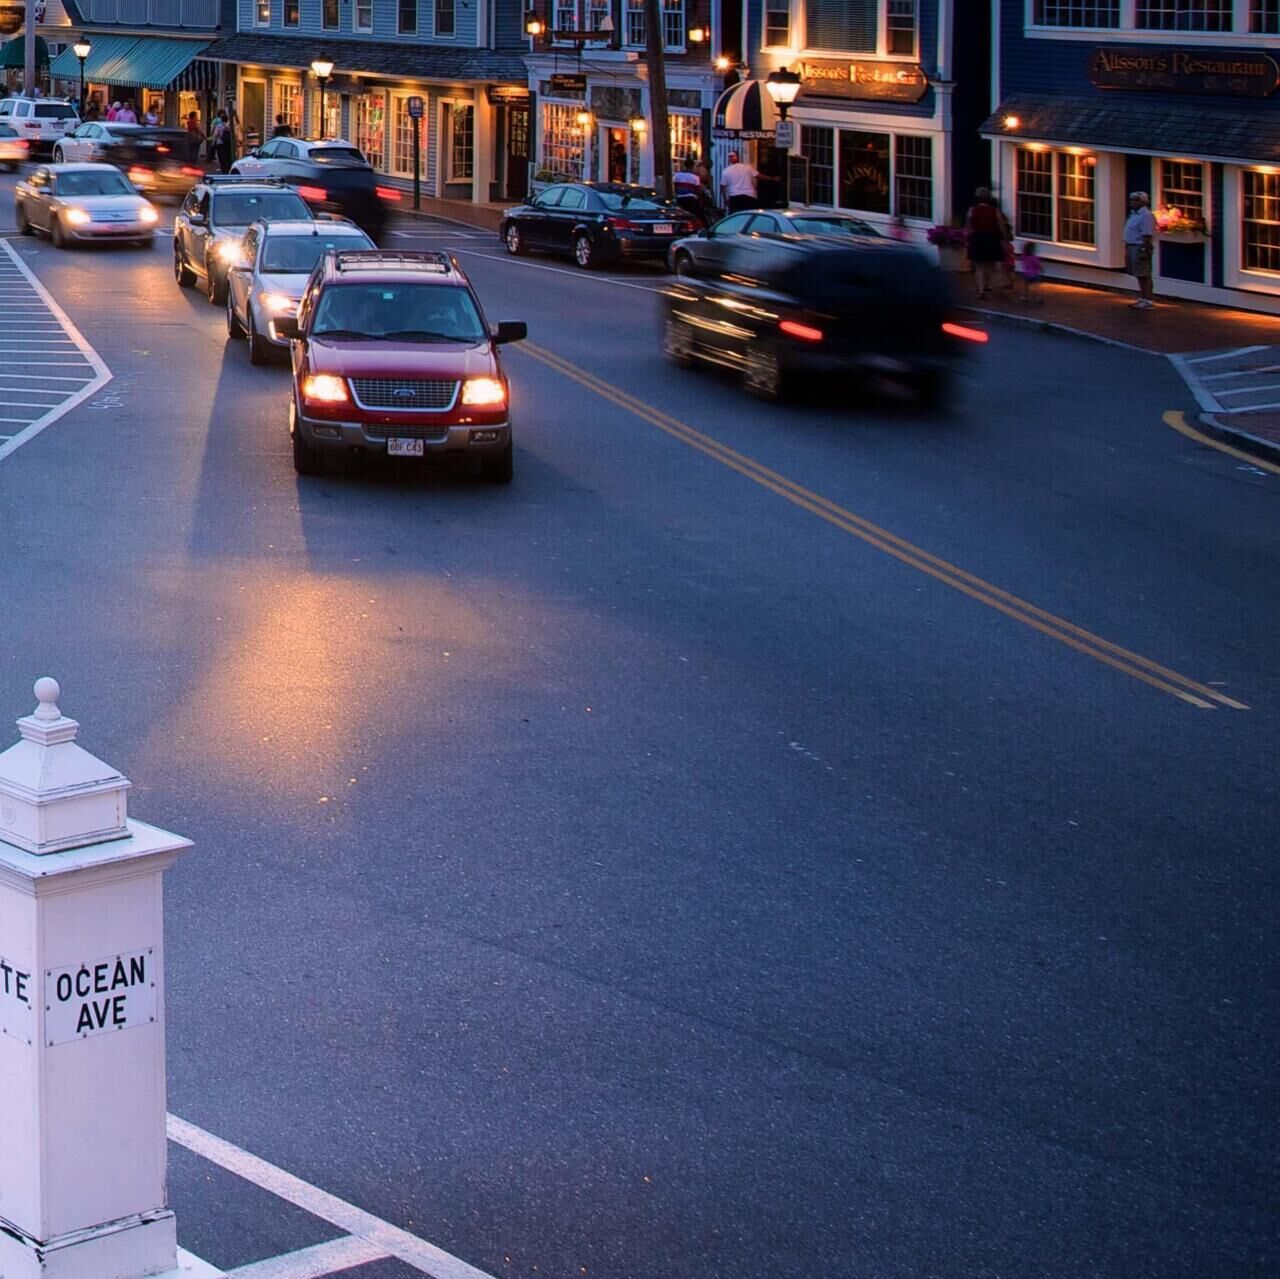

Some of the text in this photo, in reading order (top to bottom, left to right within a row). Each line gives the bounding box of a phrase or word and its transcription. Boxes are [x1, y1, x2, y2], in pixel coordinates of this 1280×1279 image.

[1093, 50, 1265, 76] Alisson's Restaurant
[56, 955, 146, 1002] OCEAN
[76, 995, 127, 1034] AVE
